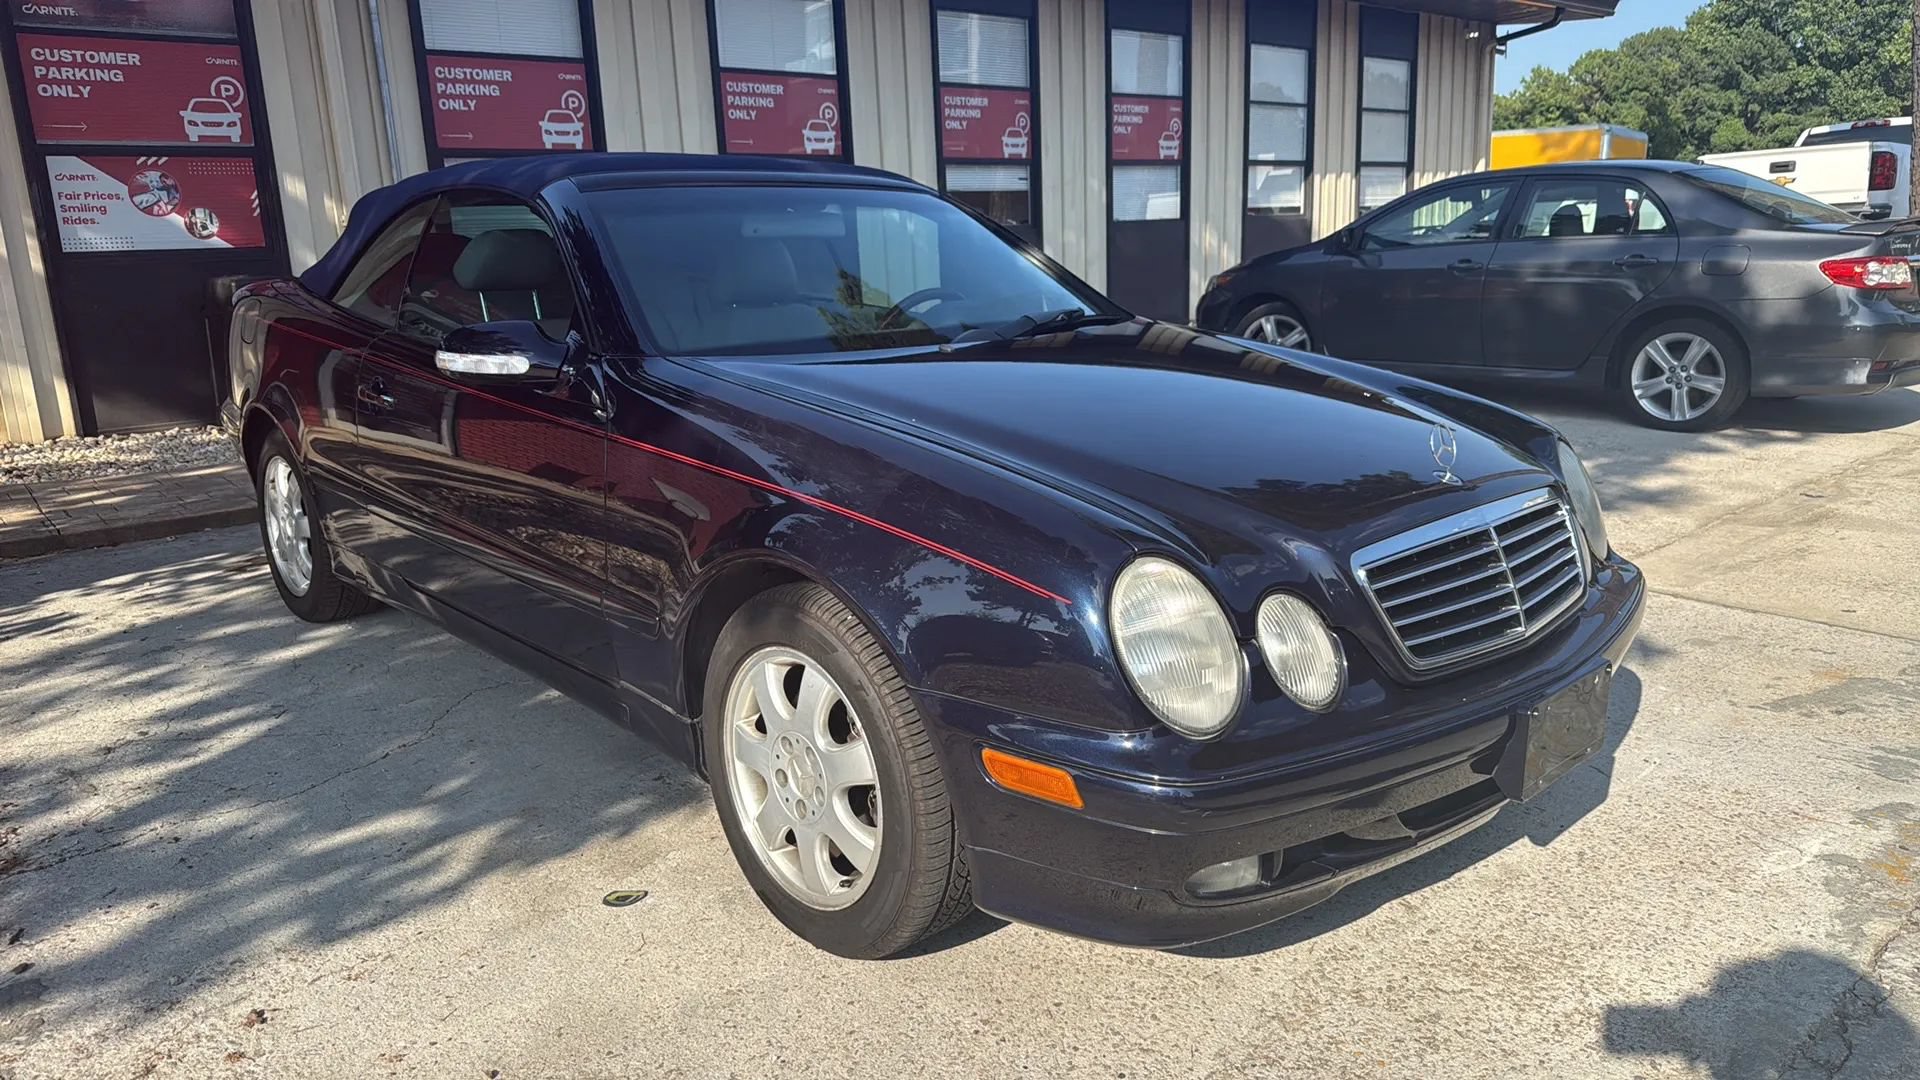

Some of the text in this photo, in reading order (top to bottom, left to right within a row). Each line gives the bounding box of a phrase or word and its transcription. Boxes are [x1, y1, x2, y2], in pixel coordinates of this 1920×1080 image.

[30, 47, 141, 66] CUSTOMER
[33, 65, 125, 82] PARKING
[434, 66, 513, 82] CUSTOMER
[37, 83, 91, 98] ONLY
[436, 82, 501, 97] PARKING
[726, 81, 784, 95] CUSTOMER
[438, 98, 477, 111] ONLY
[727, 95, 775, 108] PARKING
[944, 96, 988, 107] CUSTOMER
[728, 108, 757, 120] ONLY
[944, 108, 981, 118] PARKING
[1113, 104, 1149, 113] CUSTOMER
[945, 120, 968, 129] ONLY
[57, 190, 125, 202] Fair Prices,
[60, 203, 108, 215] Smiling
[62, 215, 100, 226] Rides.
